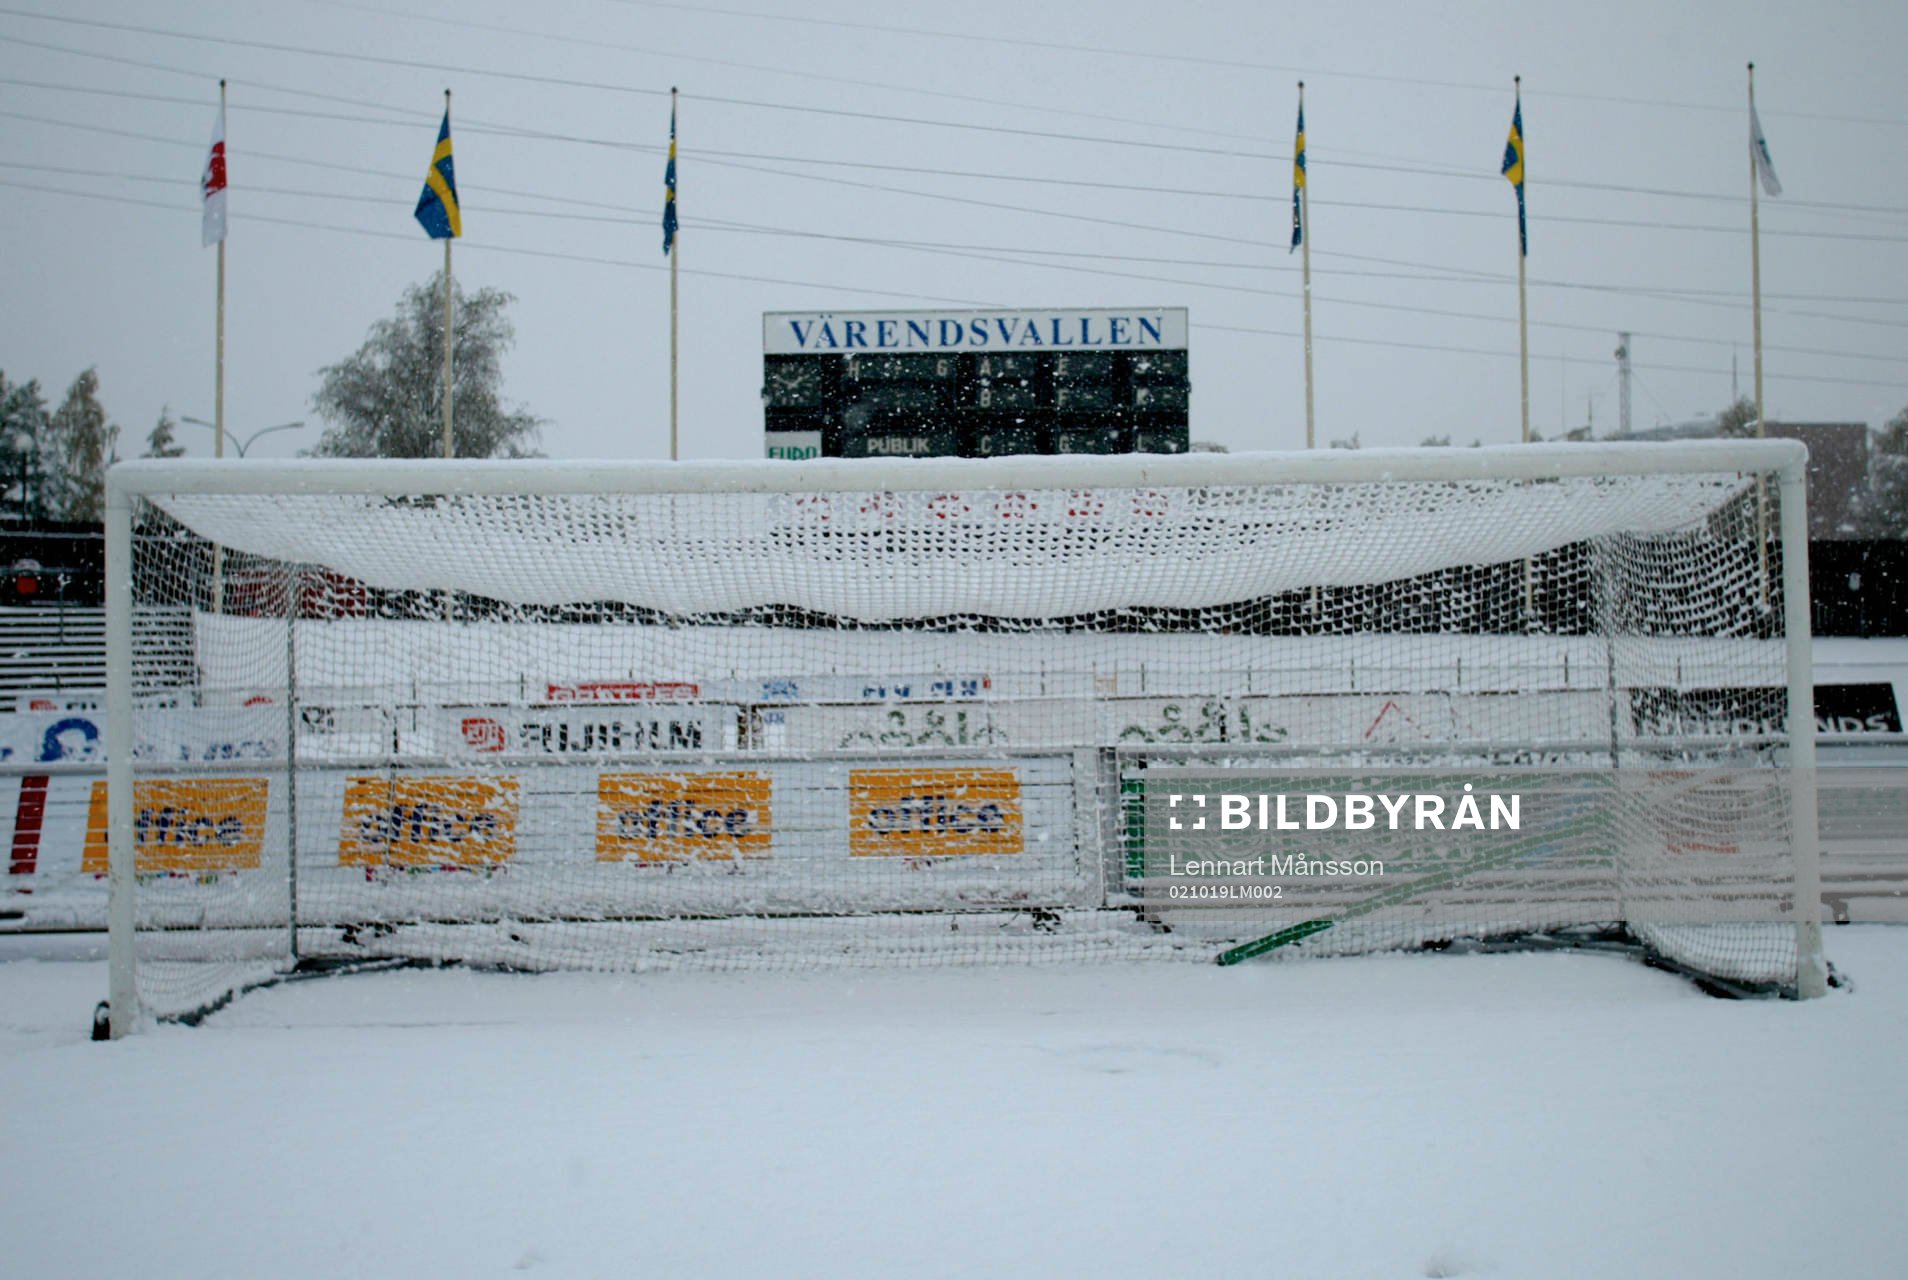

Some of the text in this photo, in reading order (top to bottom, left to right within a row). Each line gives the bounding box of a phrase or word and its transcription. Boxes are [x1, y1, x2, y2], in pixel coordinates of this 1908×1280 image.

[789, 314, 1164, 349] VÄRENDSVALLEN
[866, 437, 930, 454] PUBLIK
[617, 799, 749, 839] office
[868, 795, 1004, 834] office
